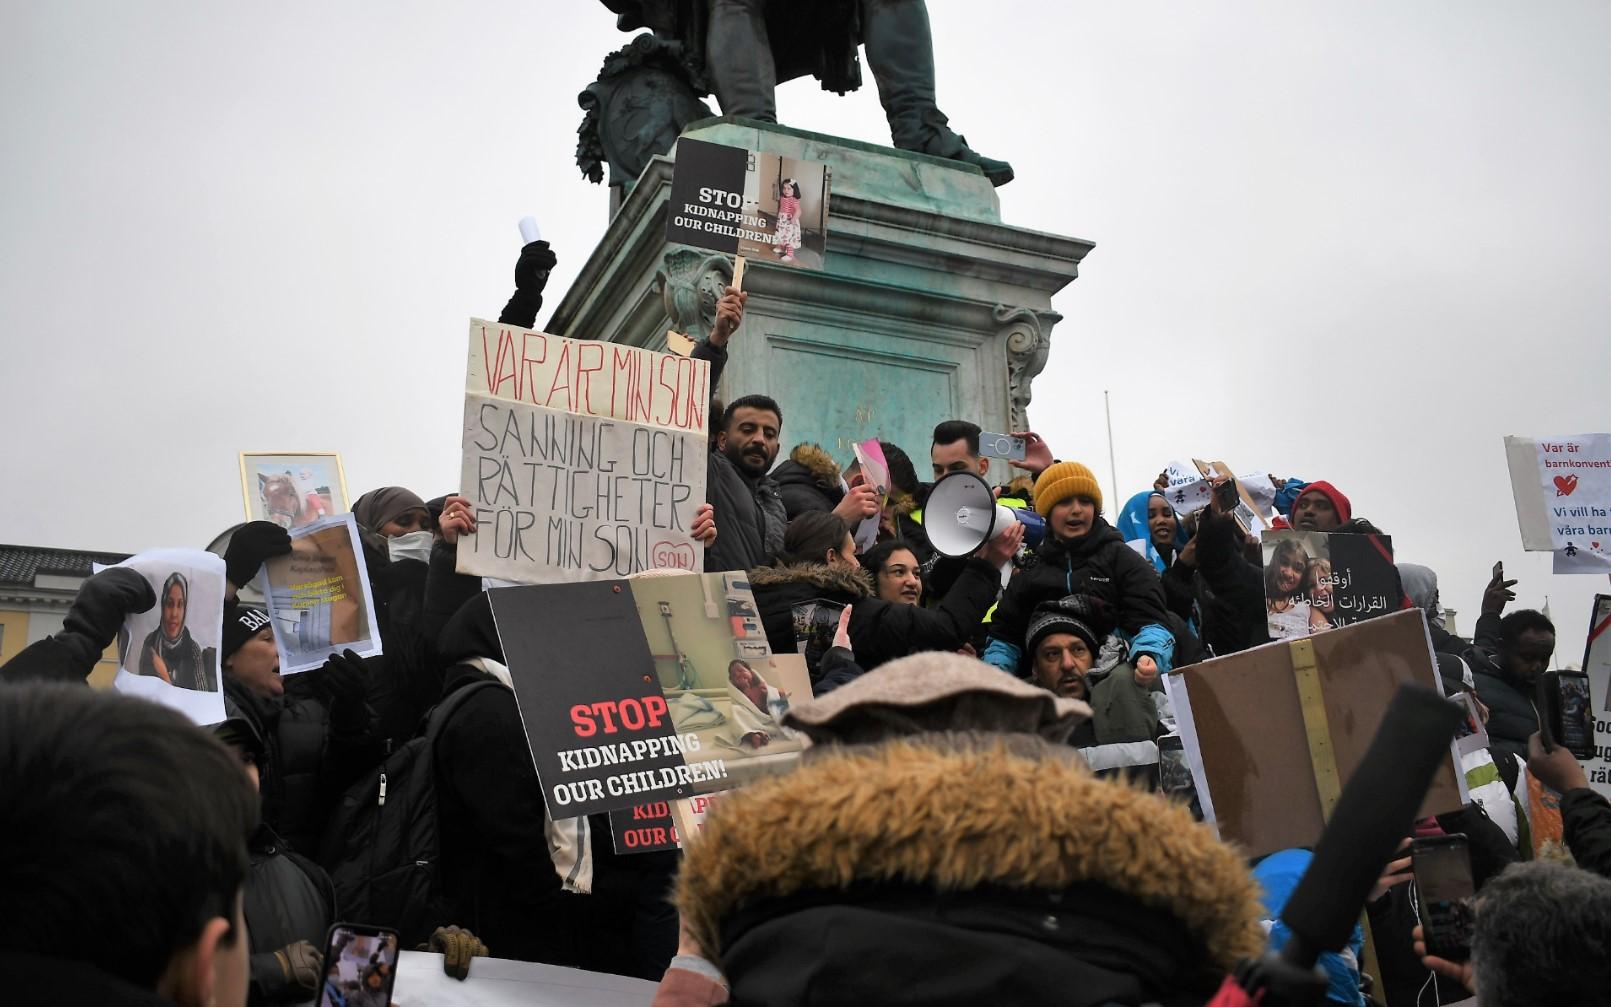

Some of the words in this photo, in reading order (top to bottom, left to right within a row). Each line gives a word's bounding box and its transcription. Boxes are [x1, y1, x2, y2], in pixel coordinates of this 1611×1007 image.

[699, 187, 757, 210] STO
[674, 216, 702, 230] OUR
[684, 203, 767, 228] KIDNAPPING
[482, 326, 547, 406] VAR
[546, 340, 604, 415] ÄR
[611, 346, 653, 424] MIN
[656, 355, 707, 430] SON
[474, 403, 618, 473] SANNING
[632, 427, 685, 483] OCH
[1541, 443, 1564, 453] Var
[1567, 442, 1580, 453] är
[478, 454, 692, 533] RÄTTIGHETER
[1553, 506, 1567, 517] Vi
[1570, 506, 1588, 517] vill
[1591, 506, 1607, 517] ha
[473, 505, 535, 562] FÖR
[546, 515, 584, 570] MIN
[588, 524, 649, 577] SON
[1557, 525, 1585, 536] våra
[656, 551, 688, 569] SON
[1315, 568, 1352, 589] أوقفوا
[1339, 594, 1387, 613] القرارات
[569, 695, 668, 738] STOP
[557, 732, 701, 772] KIDNAPPING
[553, 779, 605, 806] OUR
[606, 759, 729, 797] CHILDREN!
[623, 826, 668, 848] OUR
